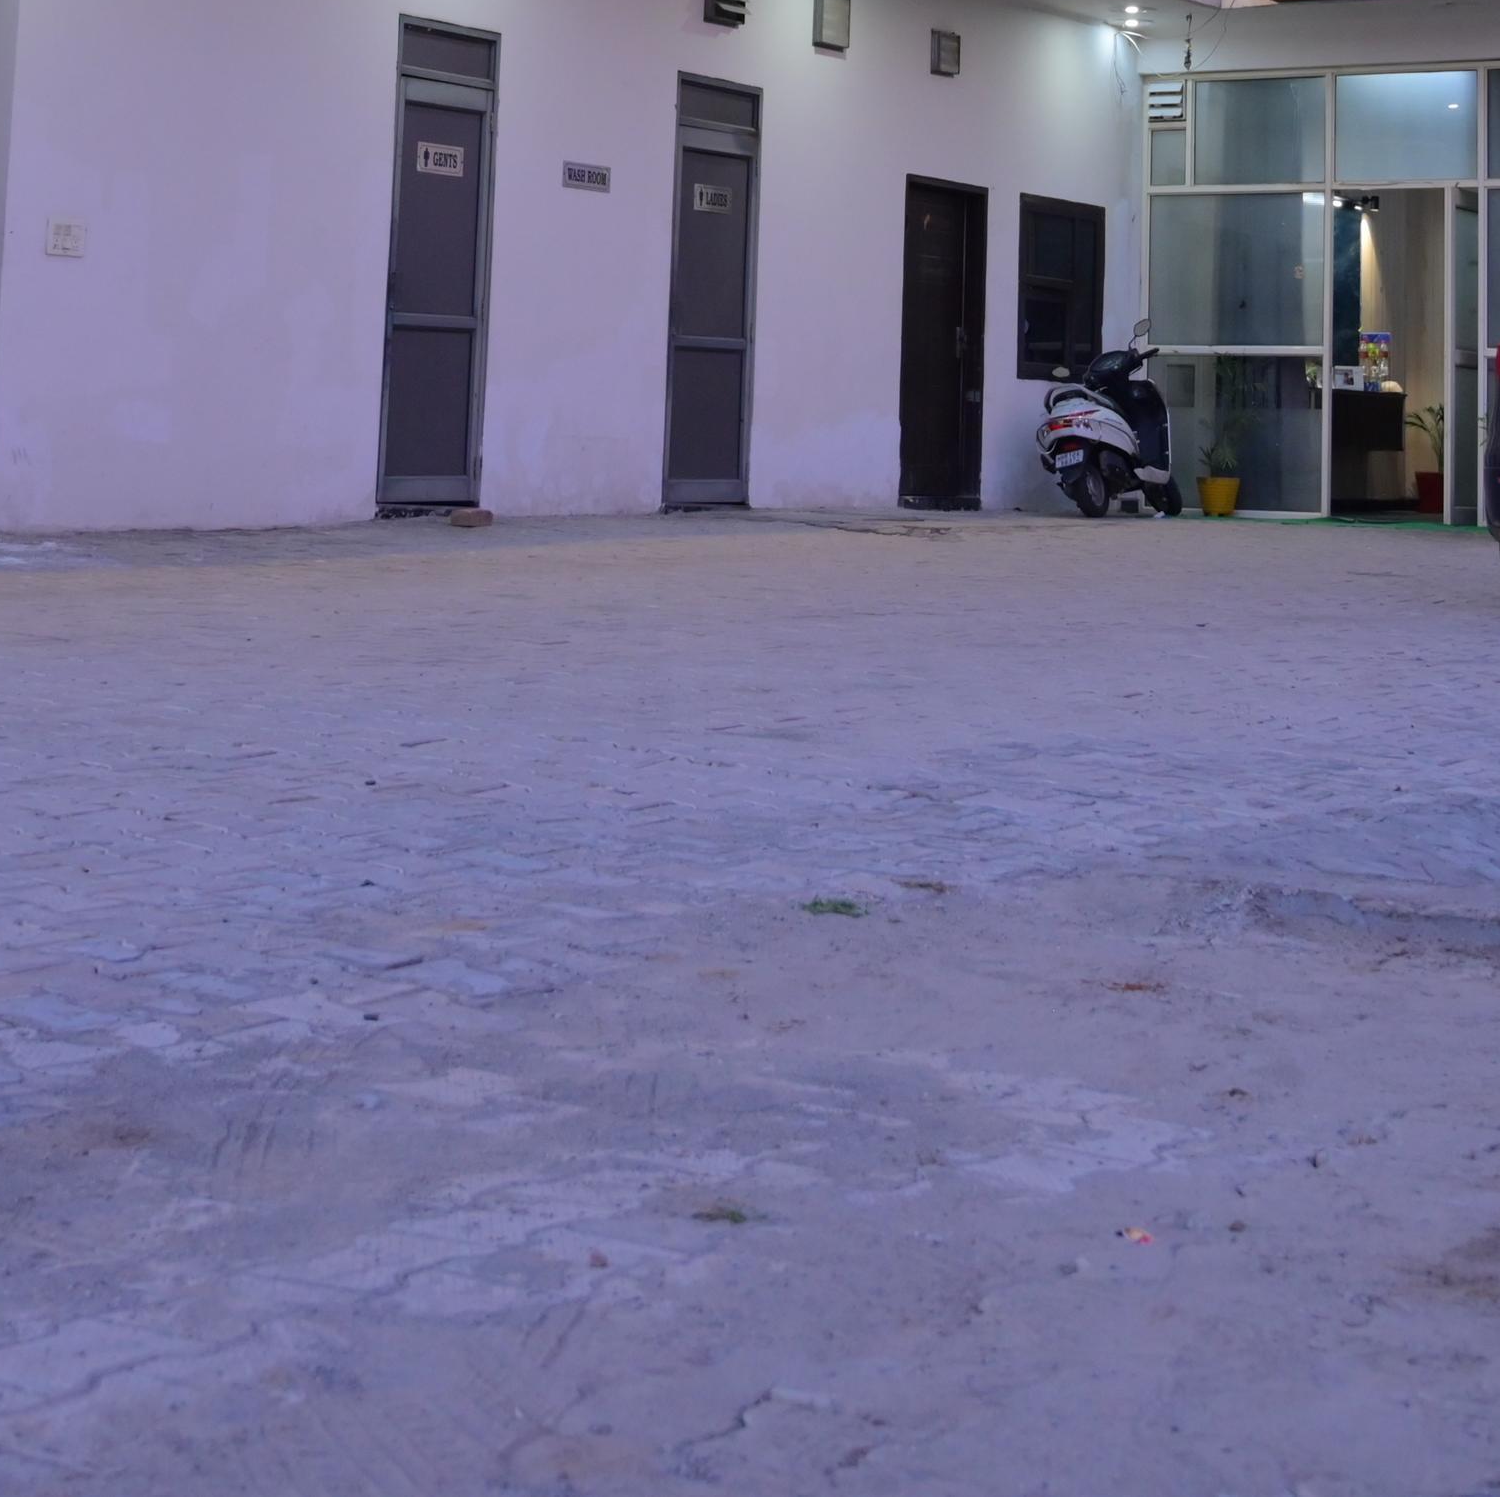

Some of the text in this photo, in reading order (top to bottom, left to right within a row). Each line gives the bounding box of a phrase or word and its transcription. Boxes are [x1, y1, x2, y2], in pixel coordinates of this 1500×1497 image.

[433, 151, 458, 169] GENTS
[567, 167, 607, 186] WASH ROOM
[706, 191, 728, 208] LADIES
